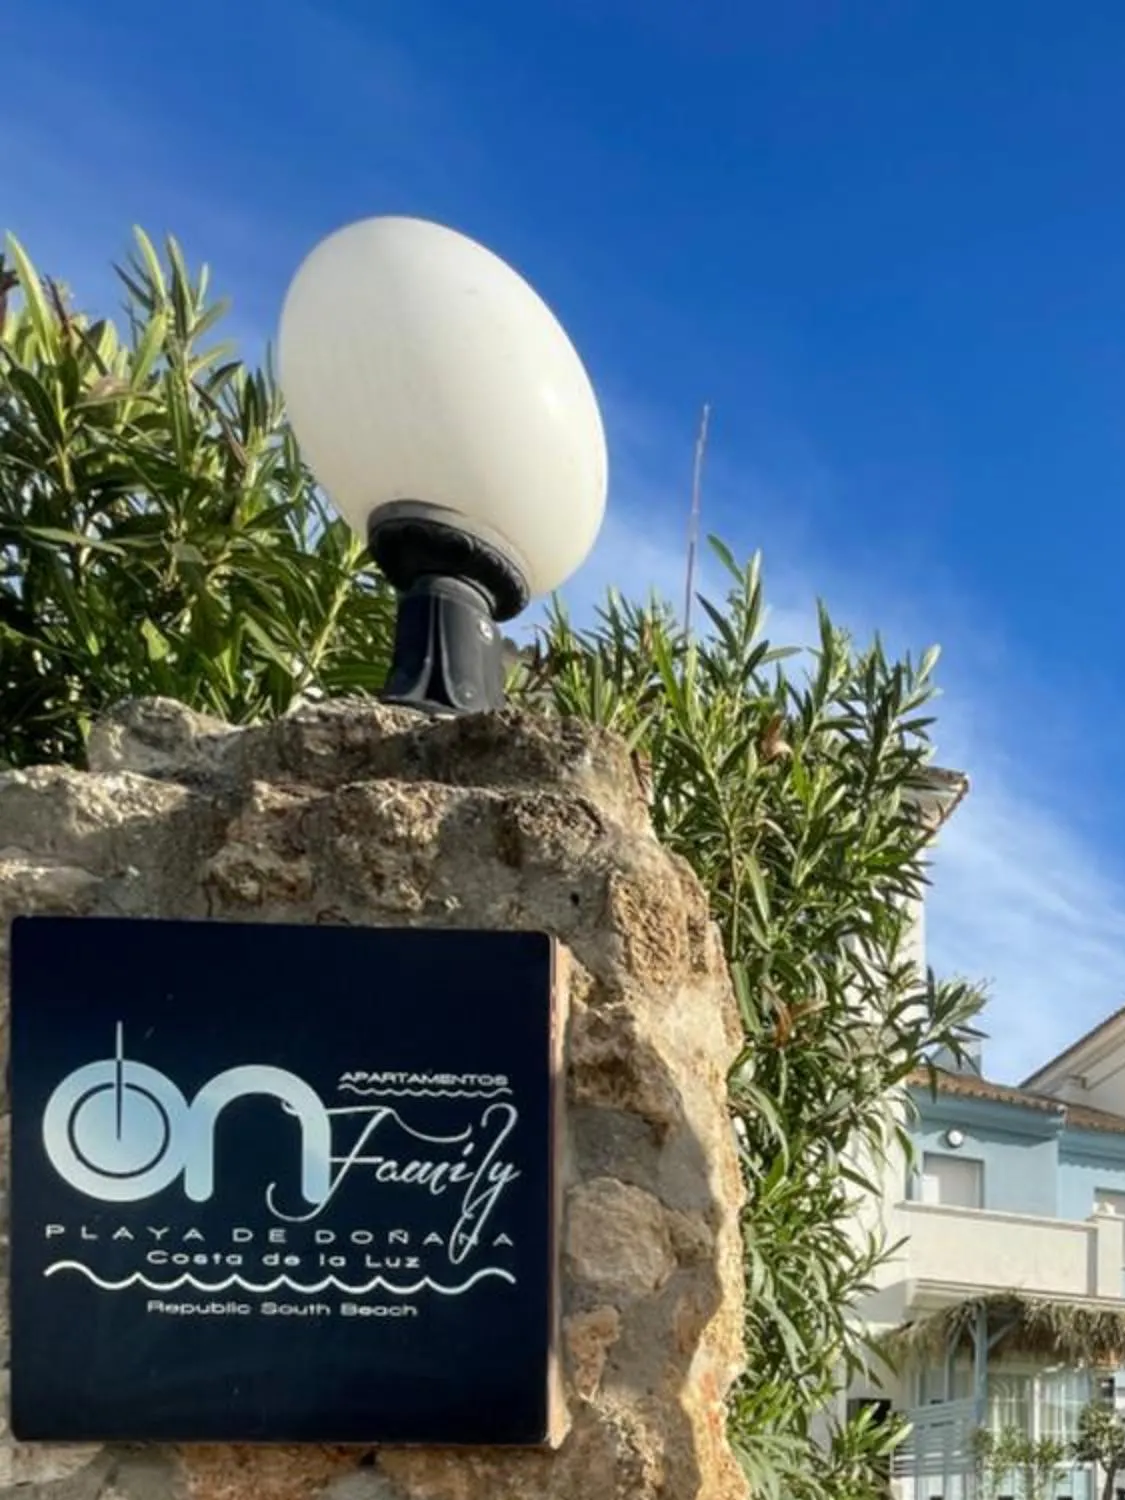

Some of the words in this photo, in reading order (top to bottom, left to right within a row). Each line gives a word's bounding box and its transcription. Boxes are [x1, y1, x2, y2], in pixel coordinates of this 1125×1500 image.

[339, 1070, 510, 1087] APARTAMENTOS
[266, 1102, 521, 1265] Family
[44, 1223, 206, 1243] PLAYA
[231, 1228, 288, 1244] DE
[315, 1228, 514, 1247] DOÑANA
[146, 1250, 244, 1267] Costa
[262, 1253, 301, 1267] de
[319, 1253, 347, 1268] la
[365, 1253, 421, 1269] Luz
[147, 1300, 252, 1316] Republic
[260, 1301, 332, 1317] South
[340, 1303, 419, 1318] Beach
